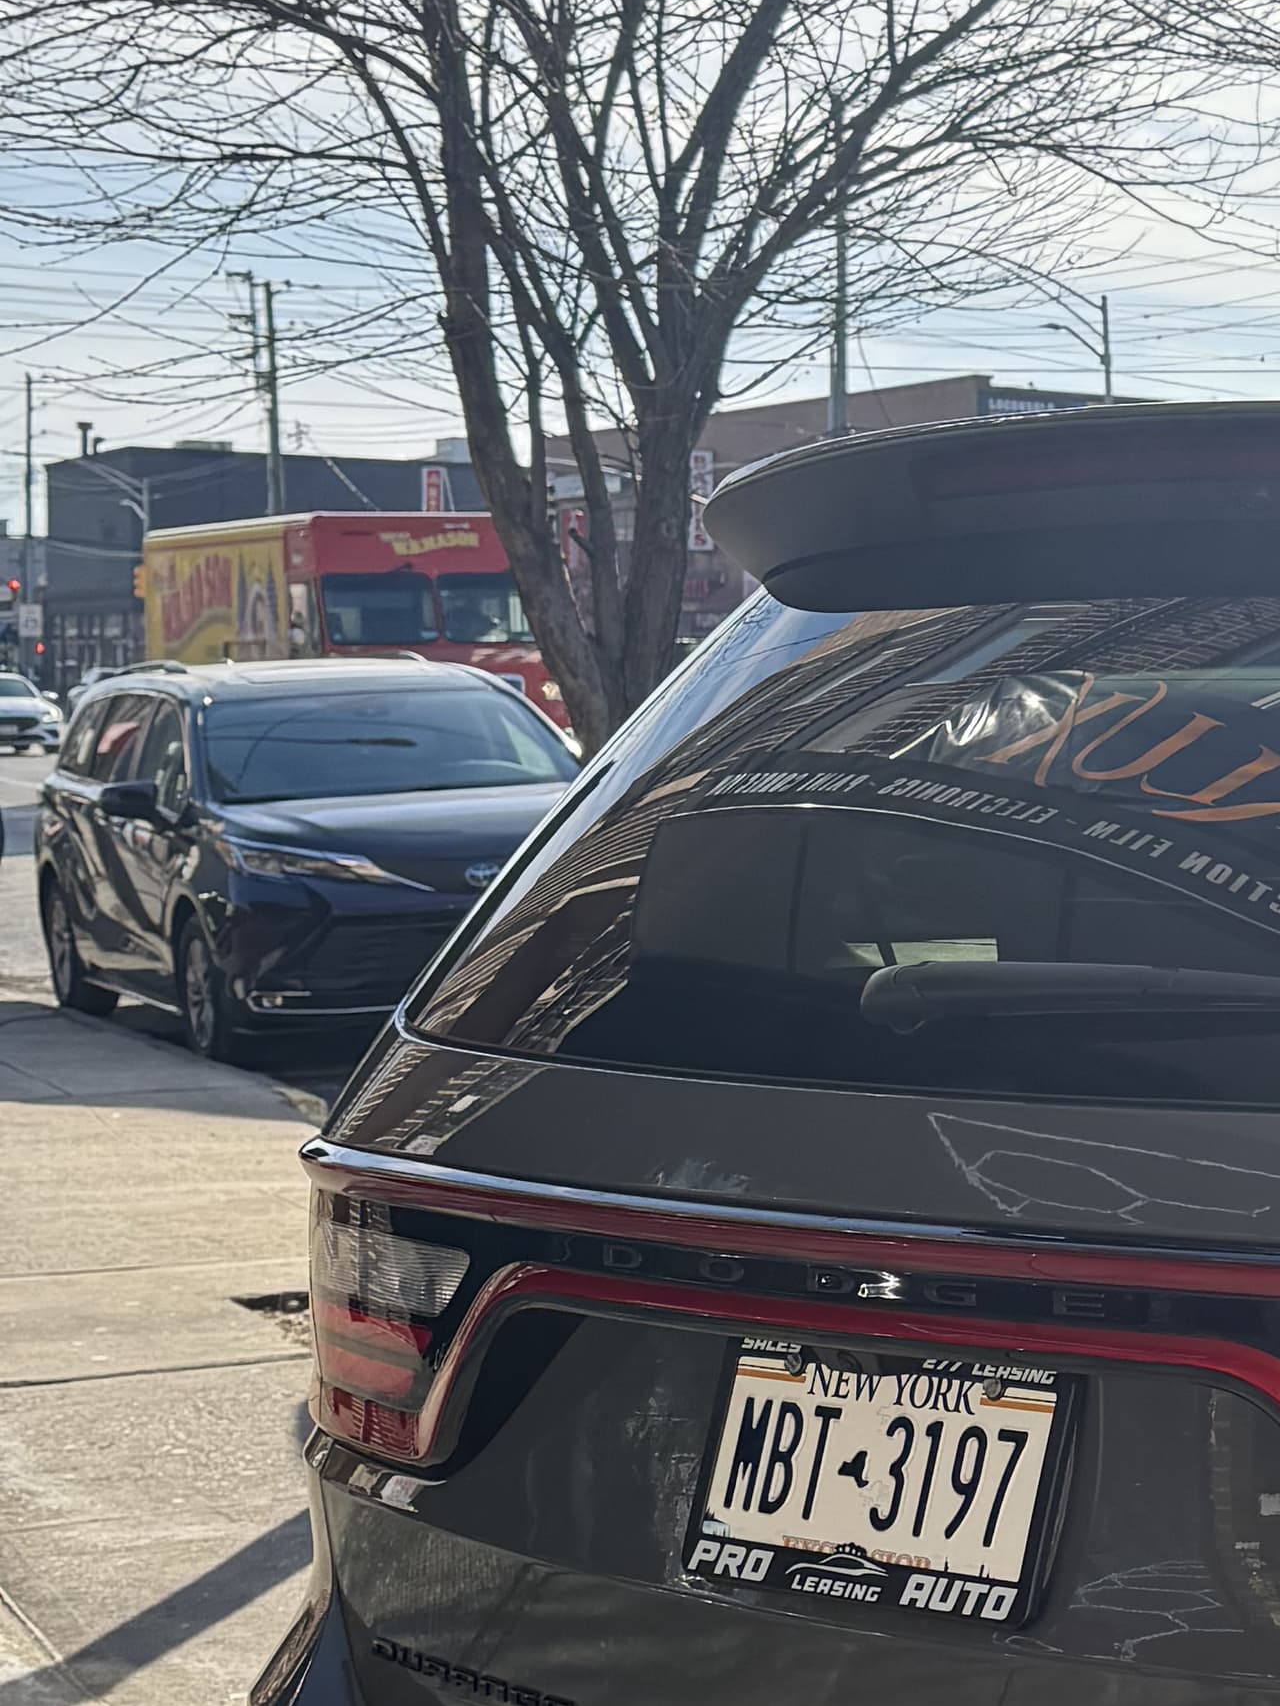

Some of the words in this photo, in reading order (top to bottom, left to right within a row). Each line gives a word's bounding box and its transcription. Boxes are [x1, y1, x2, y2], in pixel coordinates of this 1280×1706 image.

[602, 1243, 1106, 1319] DODGE
[807, 1363, 881, 1401] NEW
[892, 1373, 976, 1415] YORK
[971, 1362, 1058, 1385] LEASING
[723, 1396, 842, 1521] MBT
[869, 1415, 1029, 1548] 3197
[687, 1538, 775, 1583] PRO
[899, 1574, 1019, 1621] AUTO
[791, 1573, 881, 1603] LEASING
